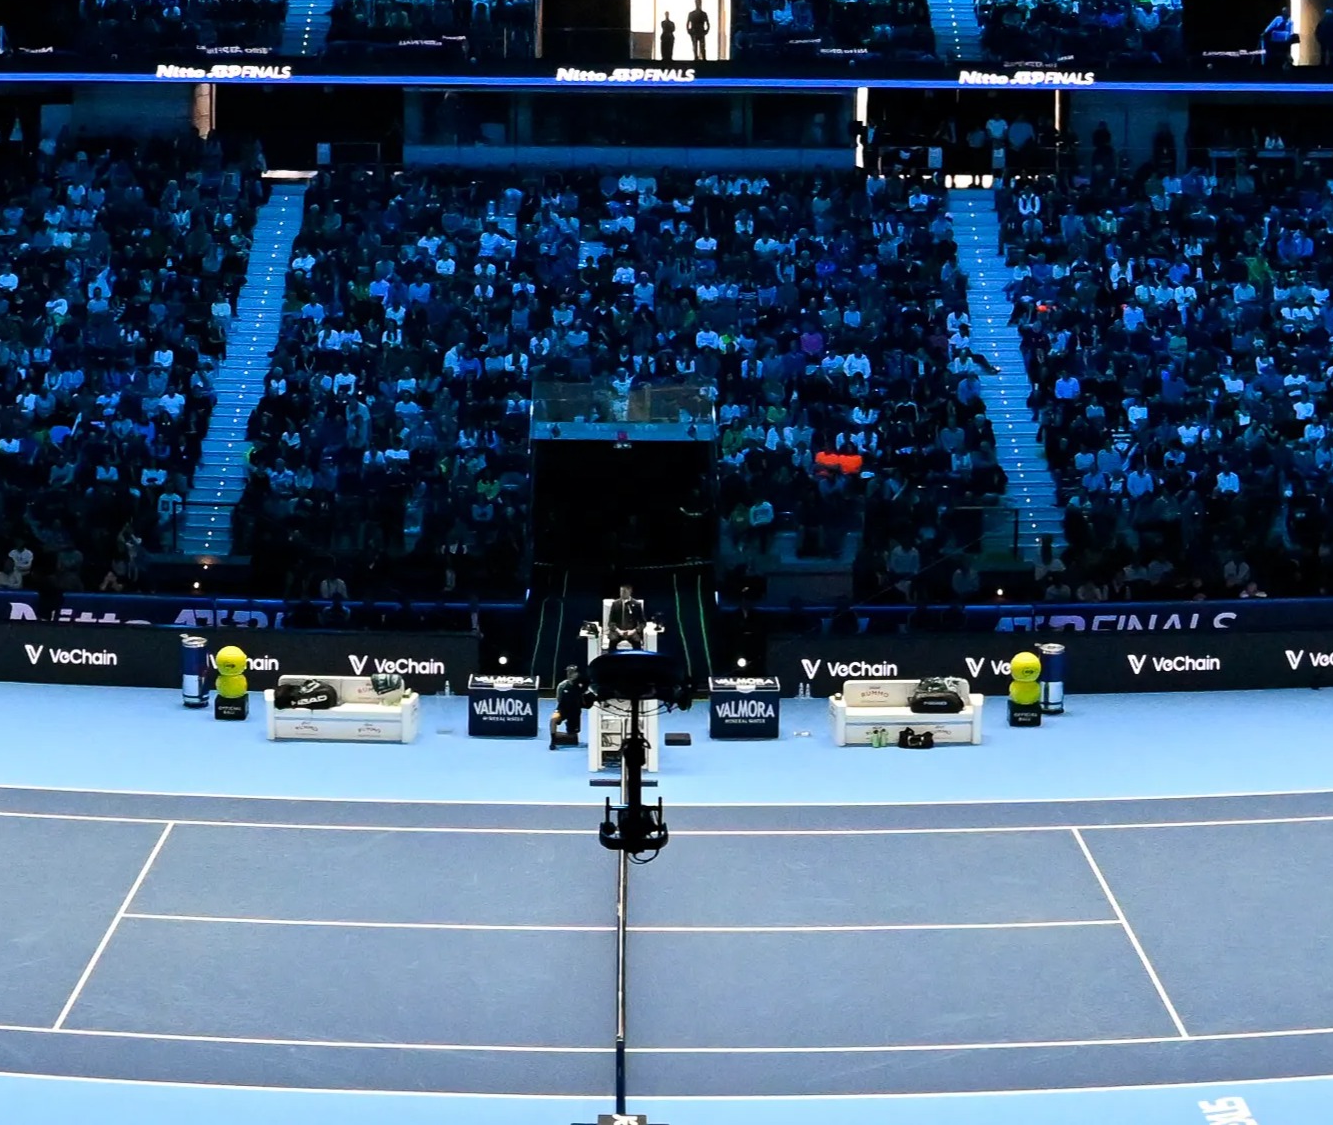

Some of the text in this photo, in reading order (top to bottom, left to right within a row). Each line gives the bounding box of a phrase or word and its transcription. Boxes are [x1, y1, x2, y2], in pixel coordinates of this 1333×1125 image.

[241, 65, 292, 79] FINALS
[643, 68, 695, 82] FINALS
[1045, 72, 1095, 86] FINALS
[49, 648, 118, 666] VeChain
[372, 657, 445, 675] VeChain
[1152, 654, 1221, 672] VeChain
[827, 660, 898, 678] VeChain
[473, 697, 533, 716] VALMORA
[715, 699, 775, 718] VALMORA
